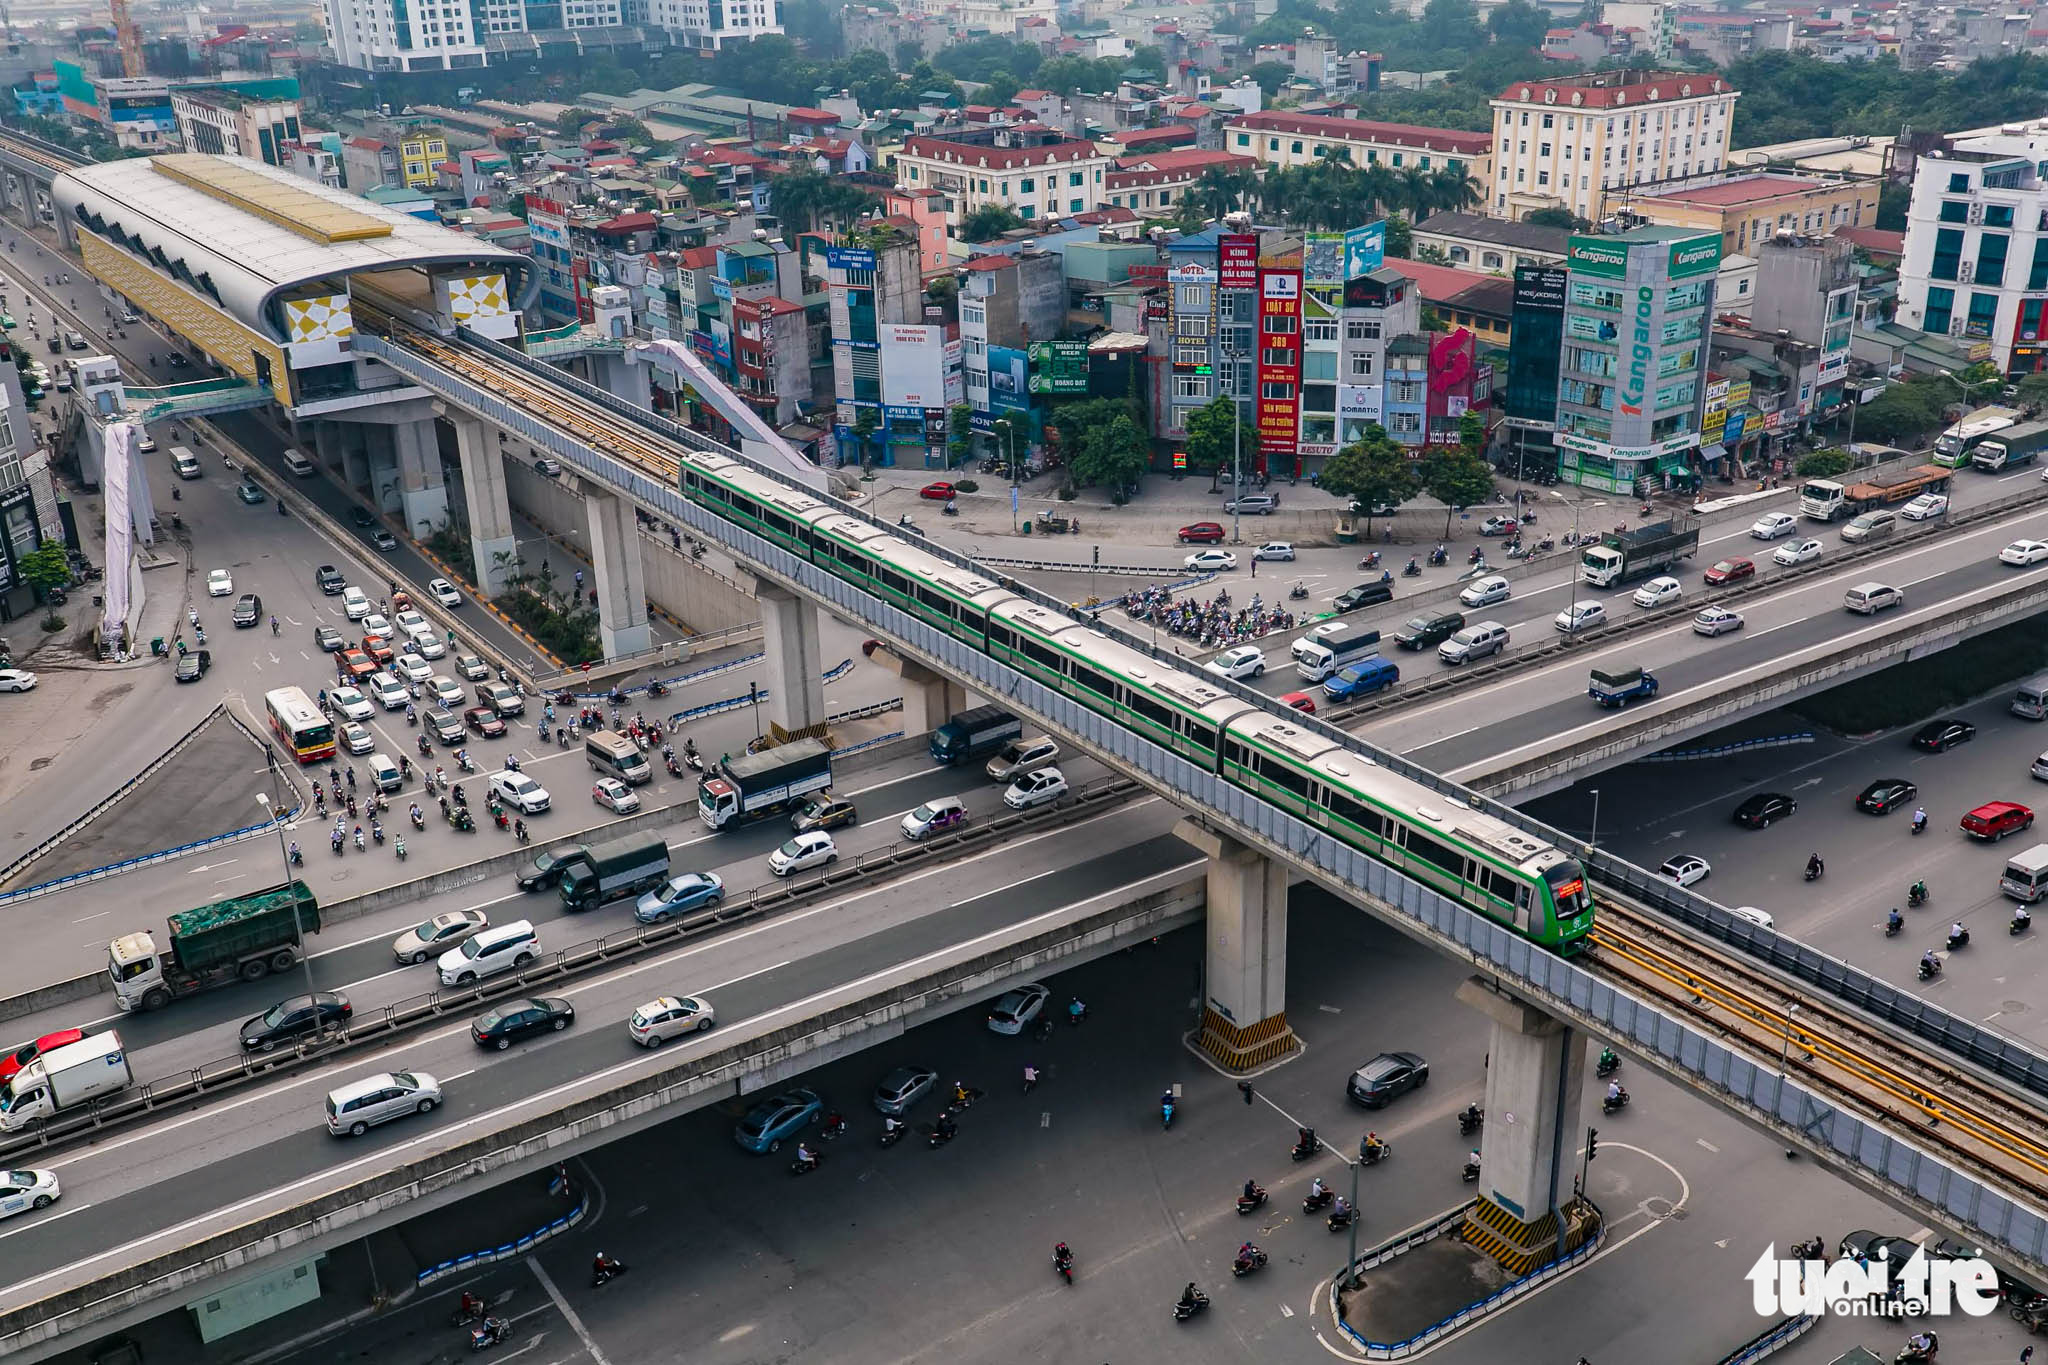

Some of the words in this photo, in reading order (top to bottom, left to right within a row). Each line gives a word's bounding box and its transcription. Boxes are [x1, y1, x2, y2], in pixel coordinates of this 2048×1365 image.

[1229, 248, 1248, 257] KÍNH
[1570, 247, 1625, 265] Kangaroo
[1673, 248, 1718, 264] Kangaroo
[1235, 259, 1255, 267] TOÀN
[1181, 266, 1206, 275] HOTEL
[1236, 270, 1256, 278] LONG
[1266, 300, 1282, 314] LUẬT
[1178, 337, 1206, 345] HOTEL
[1620, 286, 1654, 416] Kangaroo
[1562, 435, 1598, 451] Kangaroo
[1662, 439, 1690, 452] Kangaroo
[1301, 446, 1334, 454] BESUTO
[1610, 447, 1652, 457] Kangaroo
